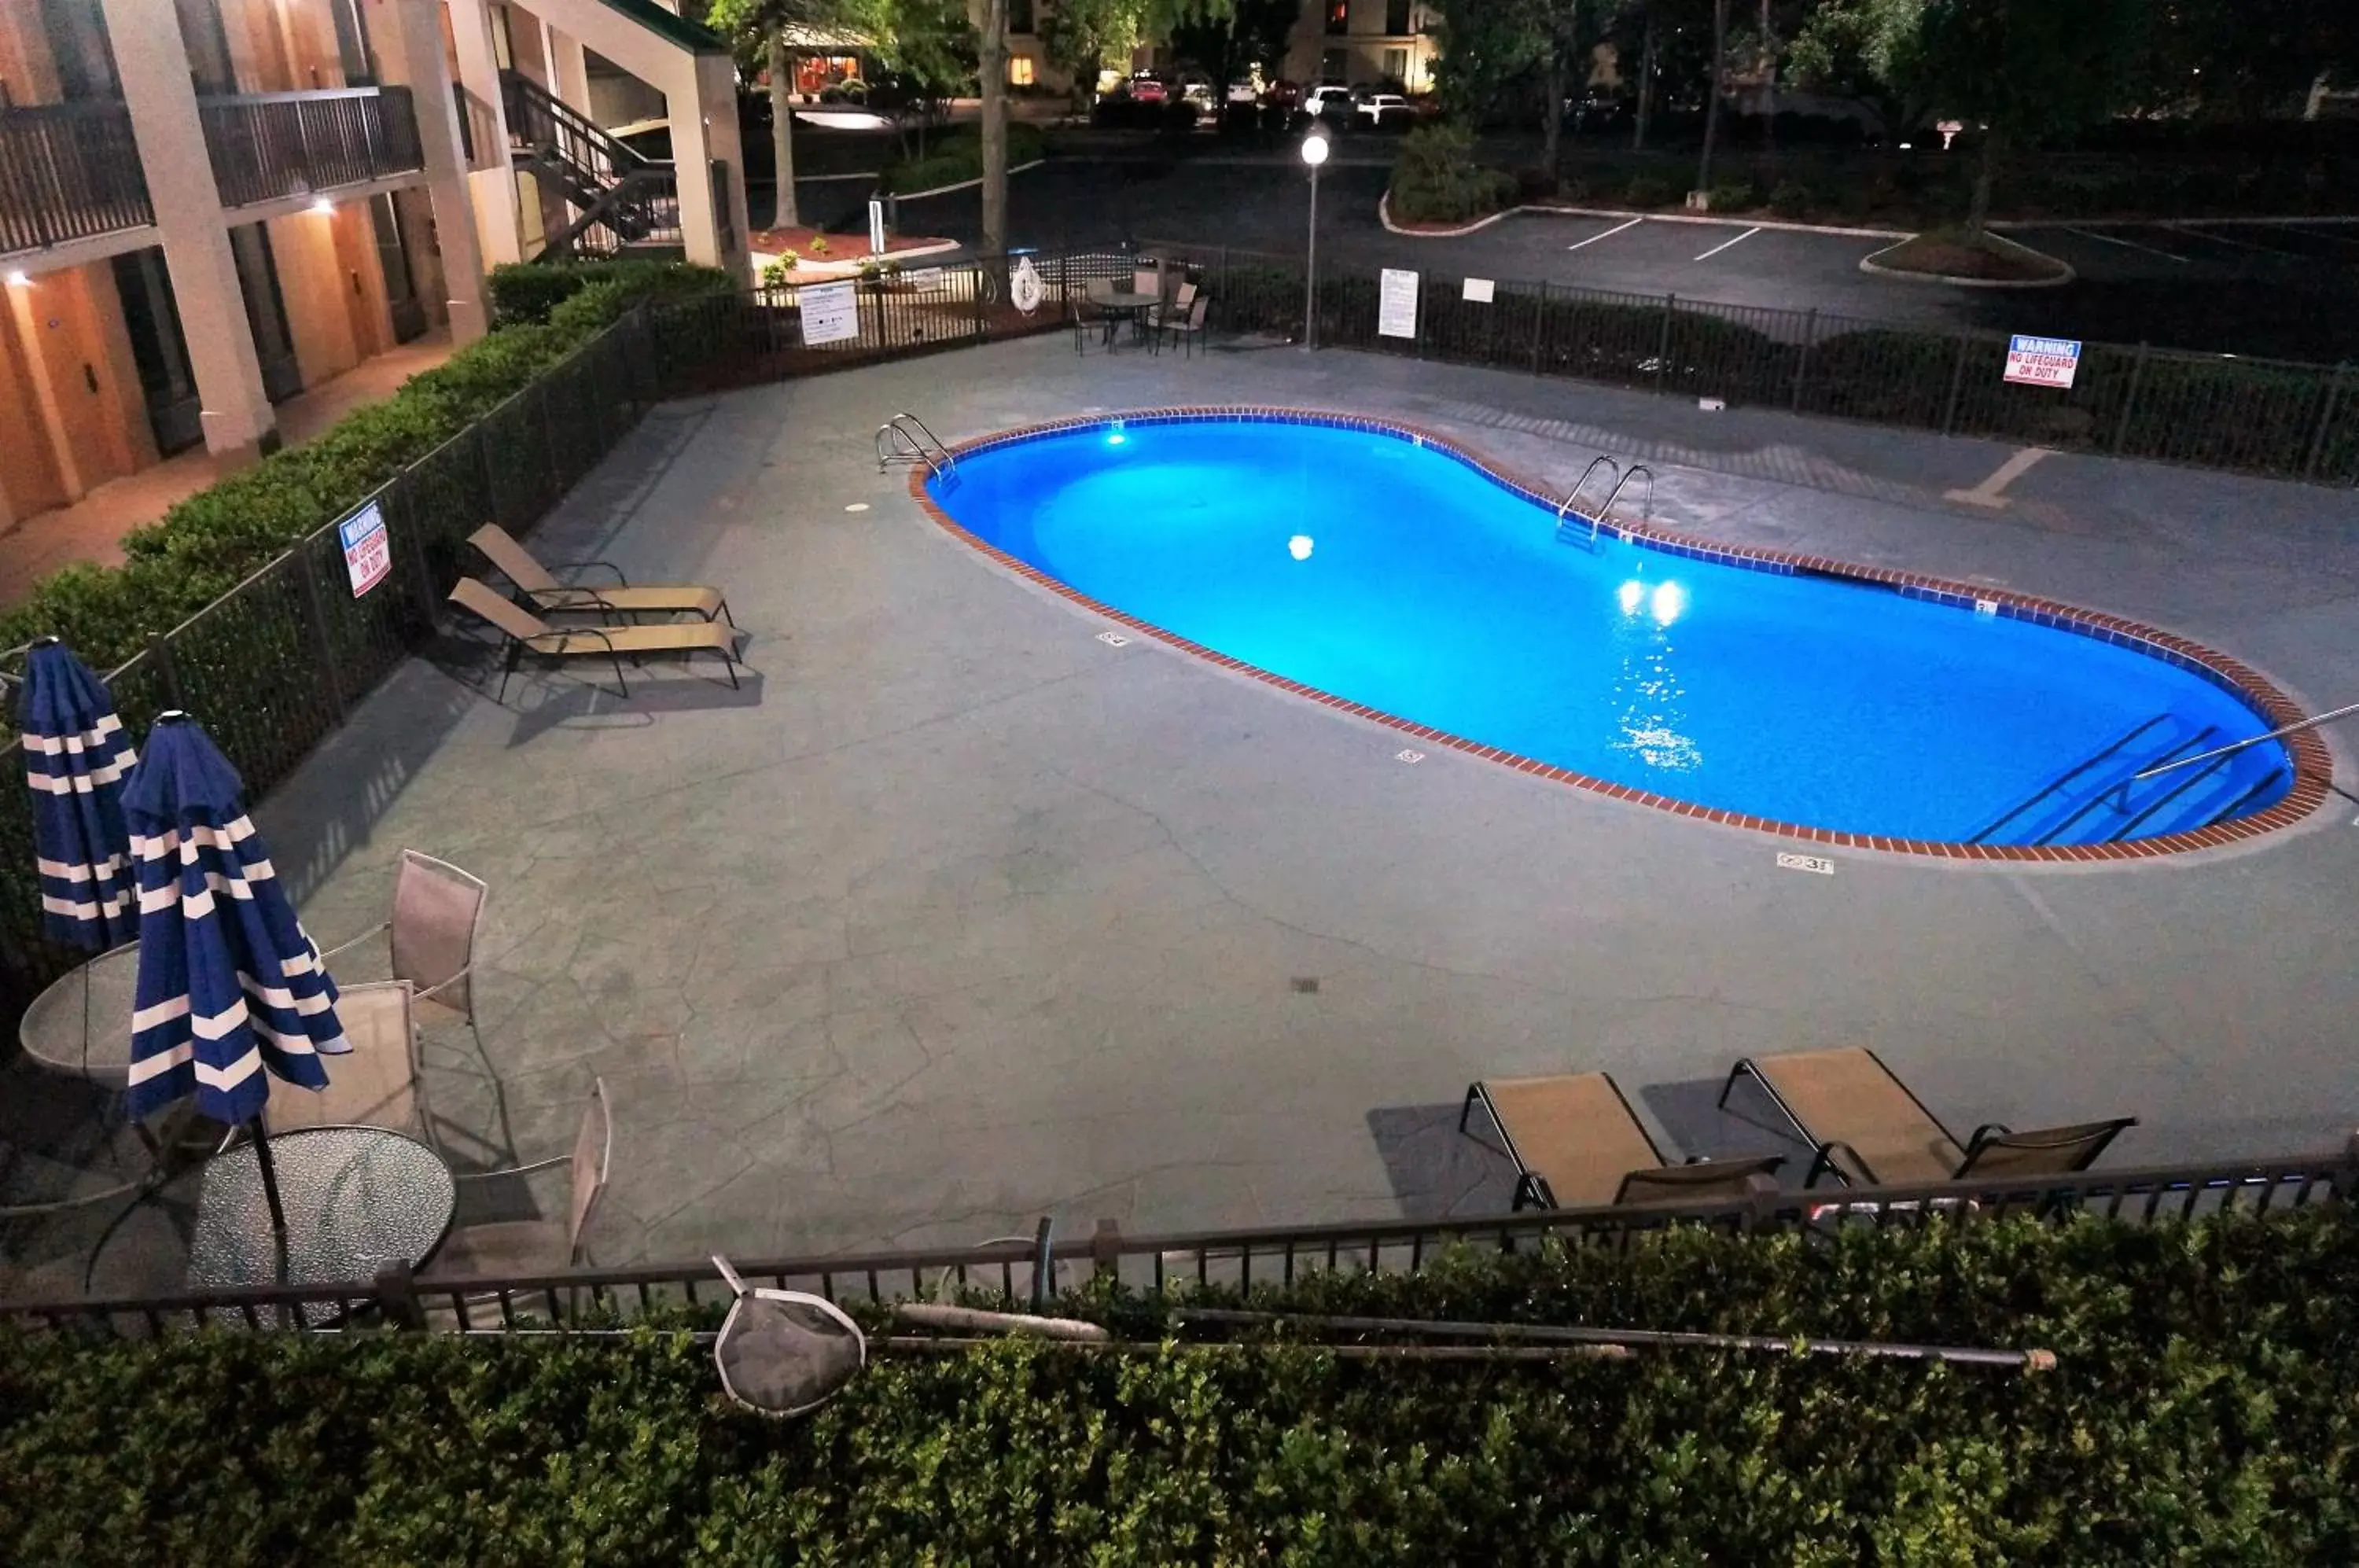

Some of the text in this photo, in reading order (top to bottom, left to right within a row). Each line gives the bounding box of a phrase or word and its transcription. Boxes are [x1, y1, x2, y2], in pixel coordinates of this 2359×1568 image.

[2015, 338, 2075, 356] WARNING
[2009, 352, 2074, 369] NO LIFEGUARD
[2019, 364, 2059, 378] ON DUTY
